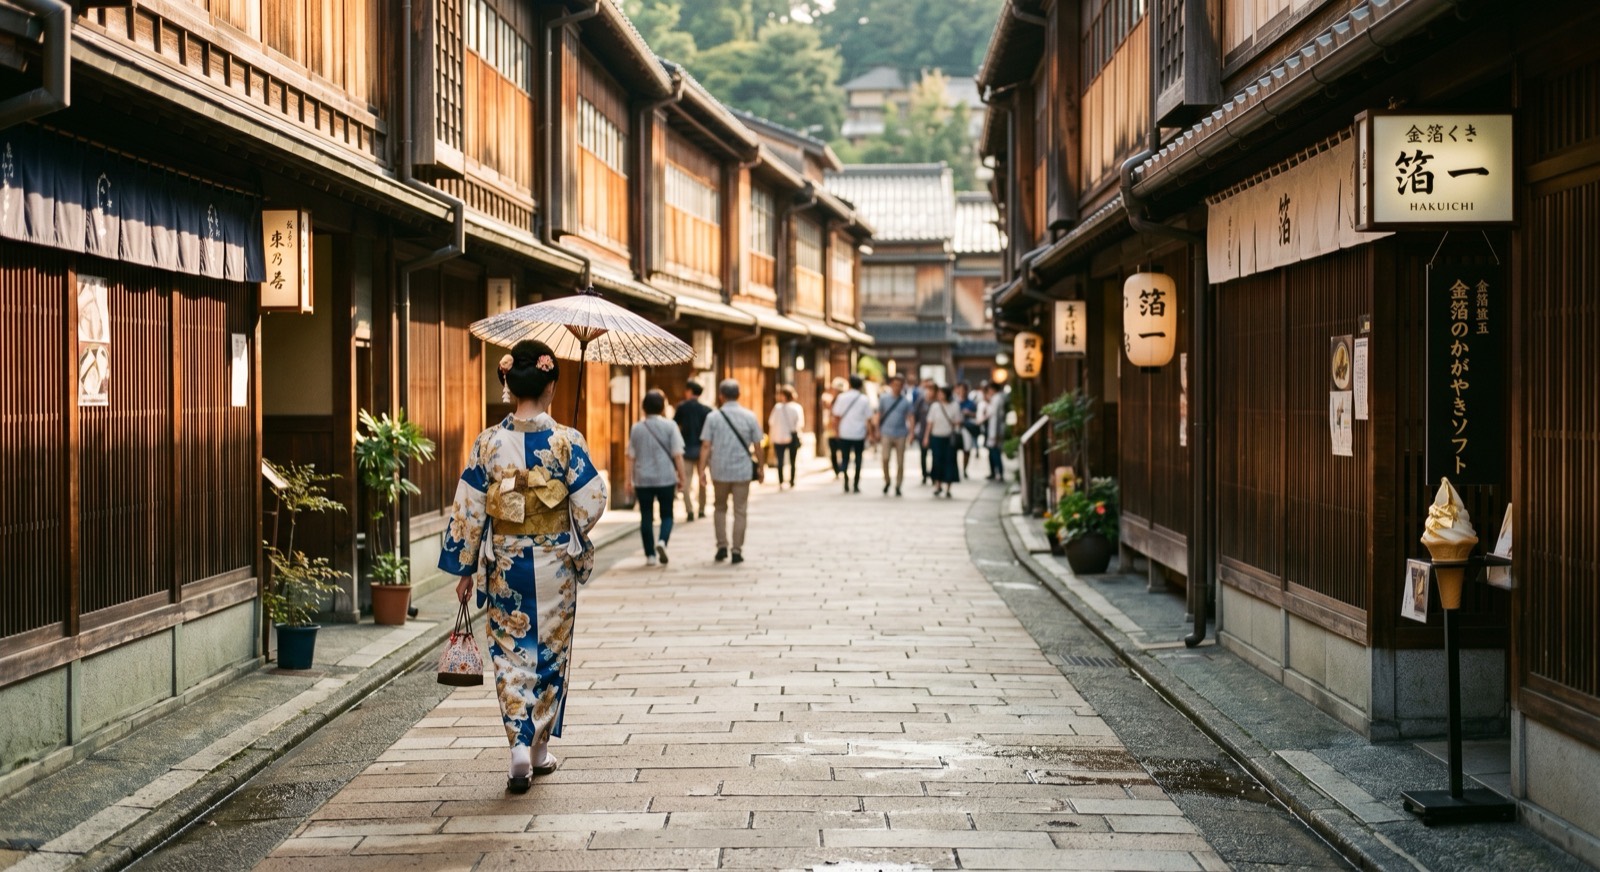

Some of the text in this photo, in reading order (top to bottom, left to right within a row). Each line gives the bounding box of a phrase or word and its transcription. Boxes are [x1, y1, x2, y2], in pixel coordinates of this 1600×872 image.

[1395, 150, 1489, 195] 箔一
[1279, 193, 1290, 246] 箔
[1410, 202, 1473, 211] HAKUICHI
[1139, 288, 1166, 338] 箔一
[1450, 280, 1469, 474] 金箔のかがやきソフト
